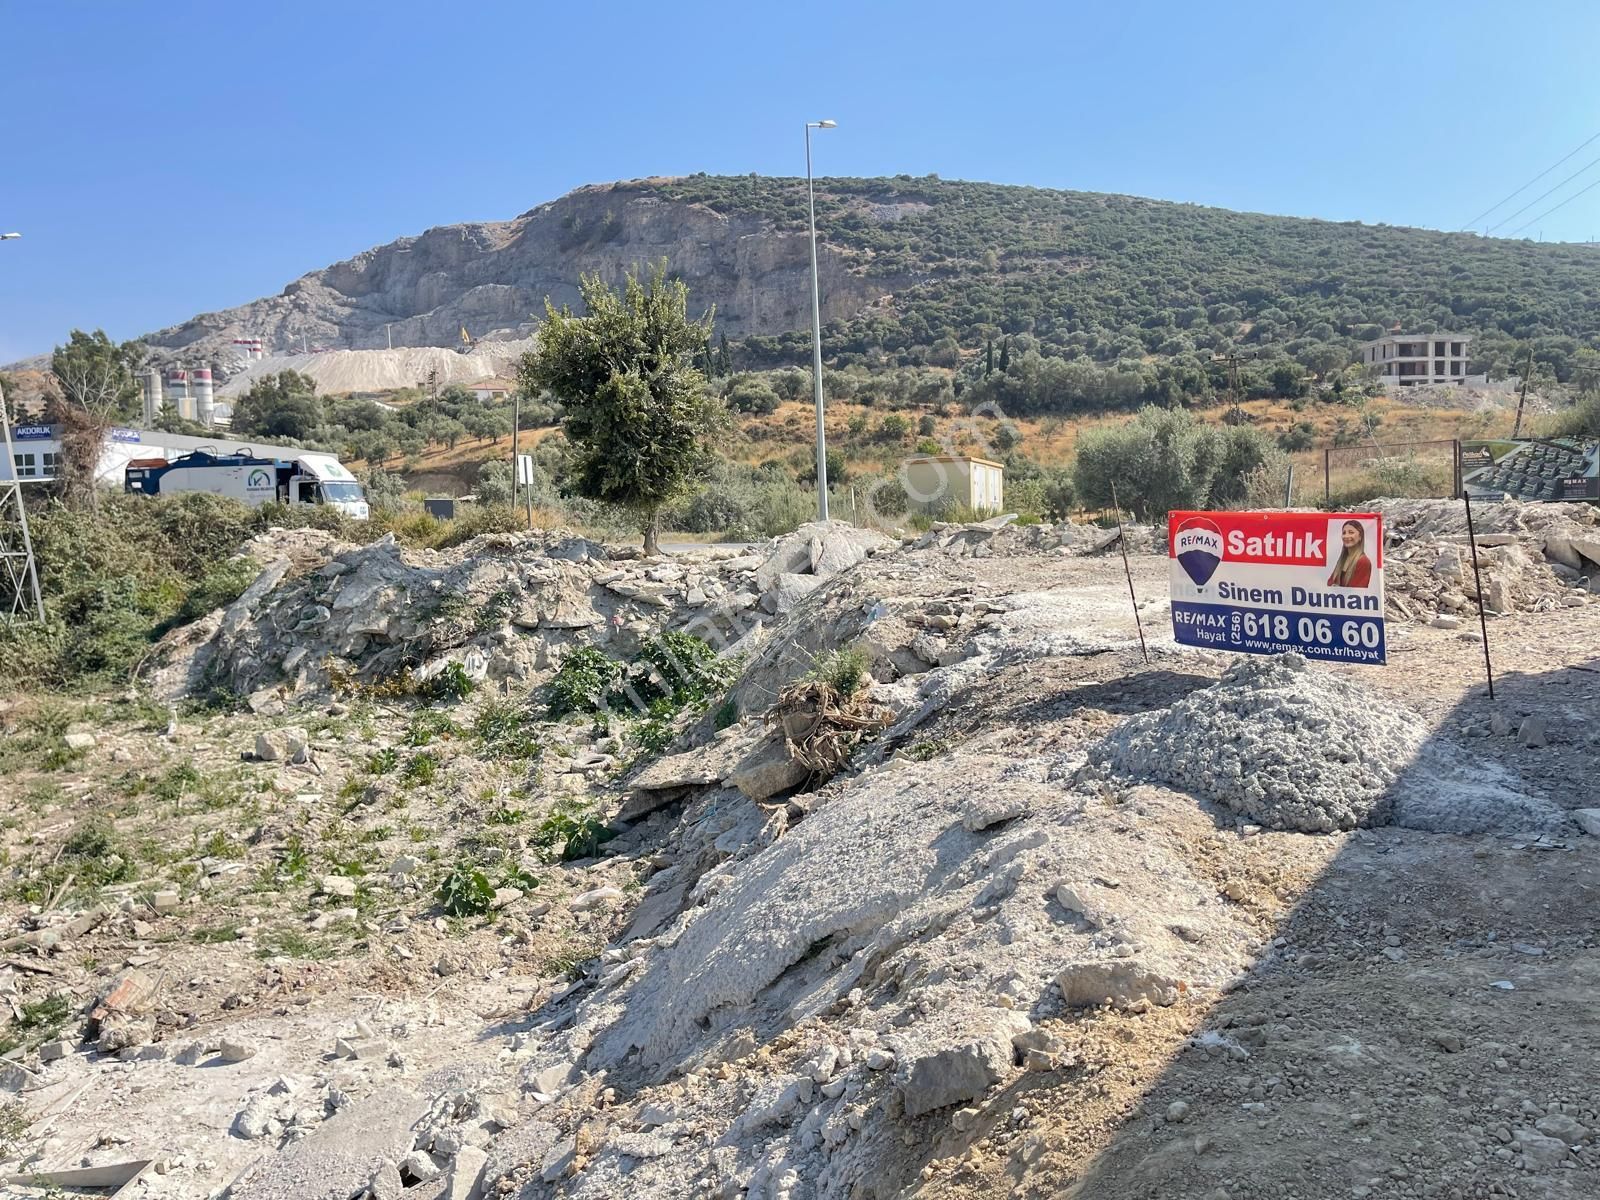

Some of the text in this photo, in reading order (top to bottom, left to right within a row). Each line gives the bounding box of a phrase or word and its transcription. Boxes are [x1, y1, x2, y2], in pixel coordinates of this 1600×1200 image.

[17, 427, 51, 436] AKDORUK
[1180, 535, 1218, 549] RE/MAX
[1227, 530, 1324, 559] Satılık
[1218, 581, 1283, 604] Sinem
[1291, 586, 1379, 610] Duman
[1175, 611, 1226, 628] RE/MAX
[1196, 628, 1226, 643] Hayat
[1231, 611, 1380, 648] (256) 618 06 60
[1245, 639, 1380, 660] www.remax.com.tr/hayat
